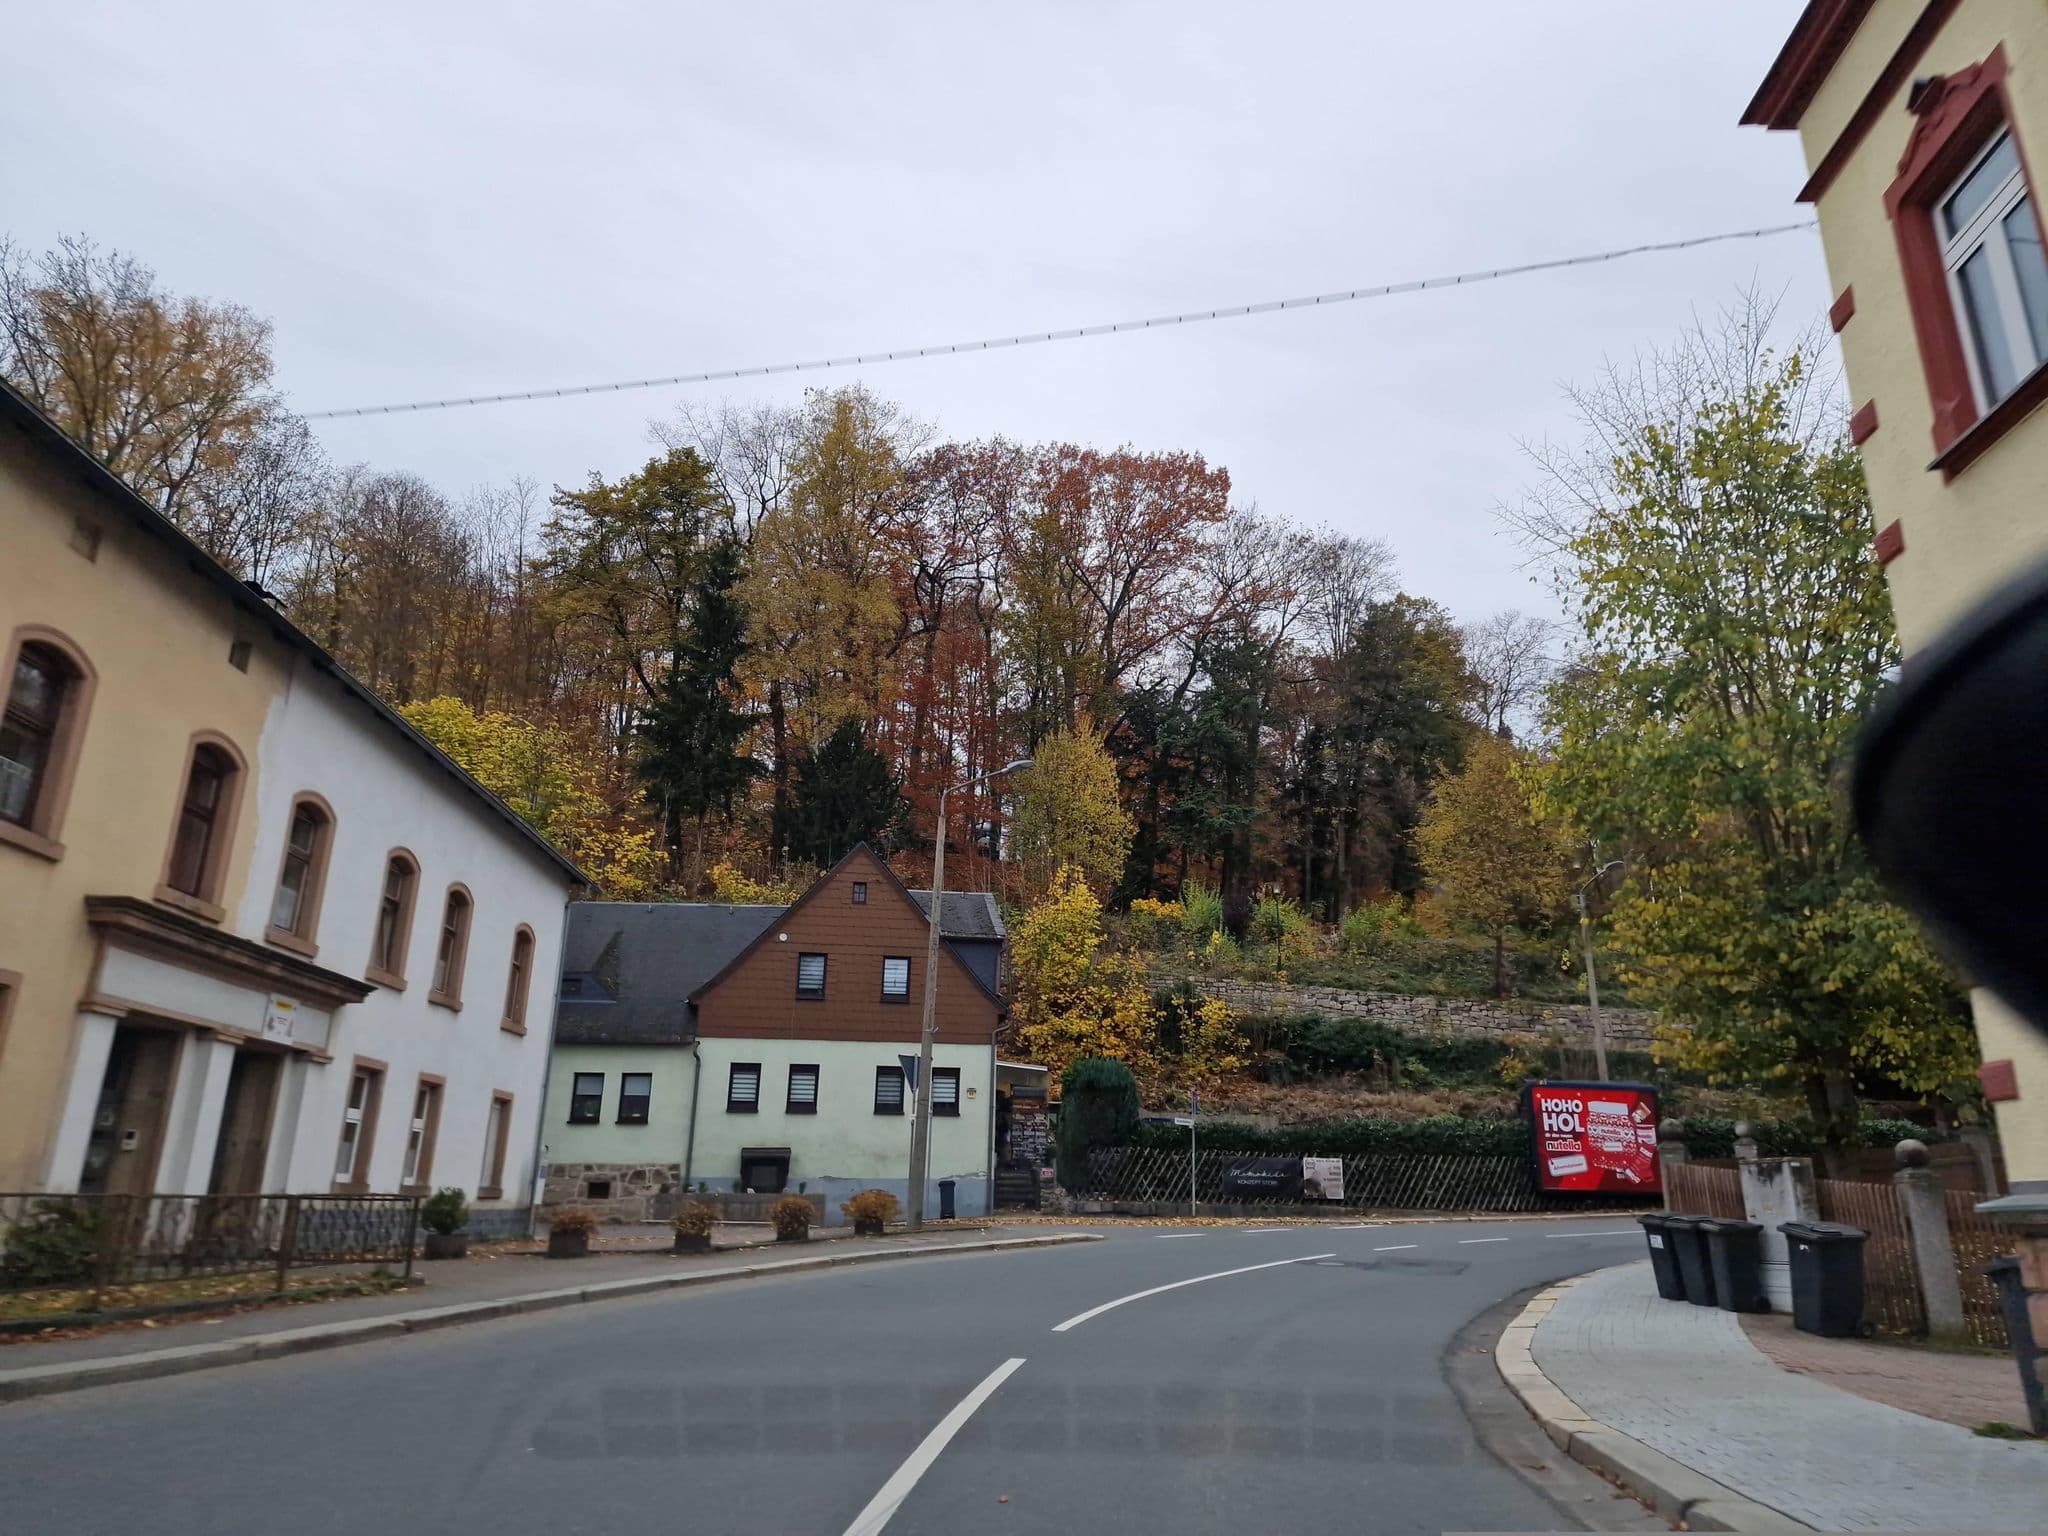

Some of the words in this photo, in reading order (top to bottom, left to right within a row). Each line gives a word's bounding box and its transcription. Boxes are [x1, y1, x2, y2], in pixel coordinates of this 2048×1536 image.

[1541, 1098, 1583, 1113] HOHO
[1543, 1112, 1585, 1133] HOL
[1546, 1139, 1582, 1151] nutella
